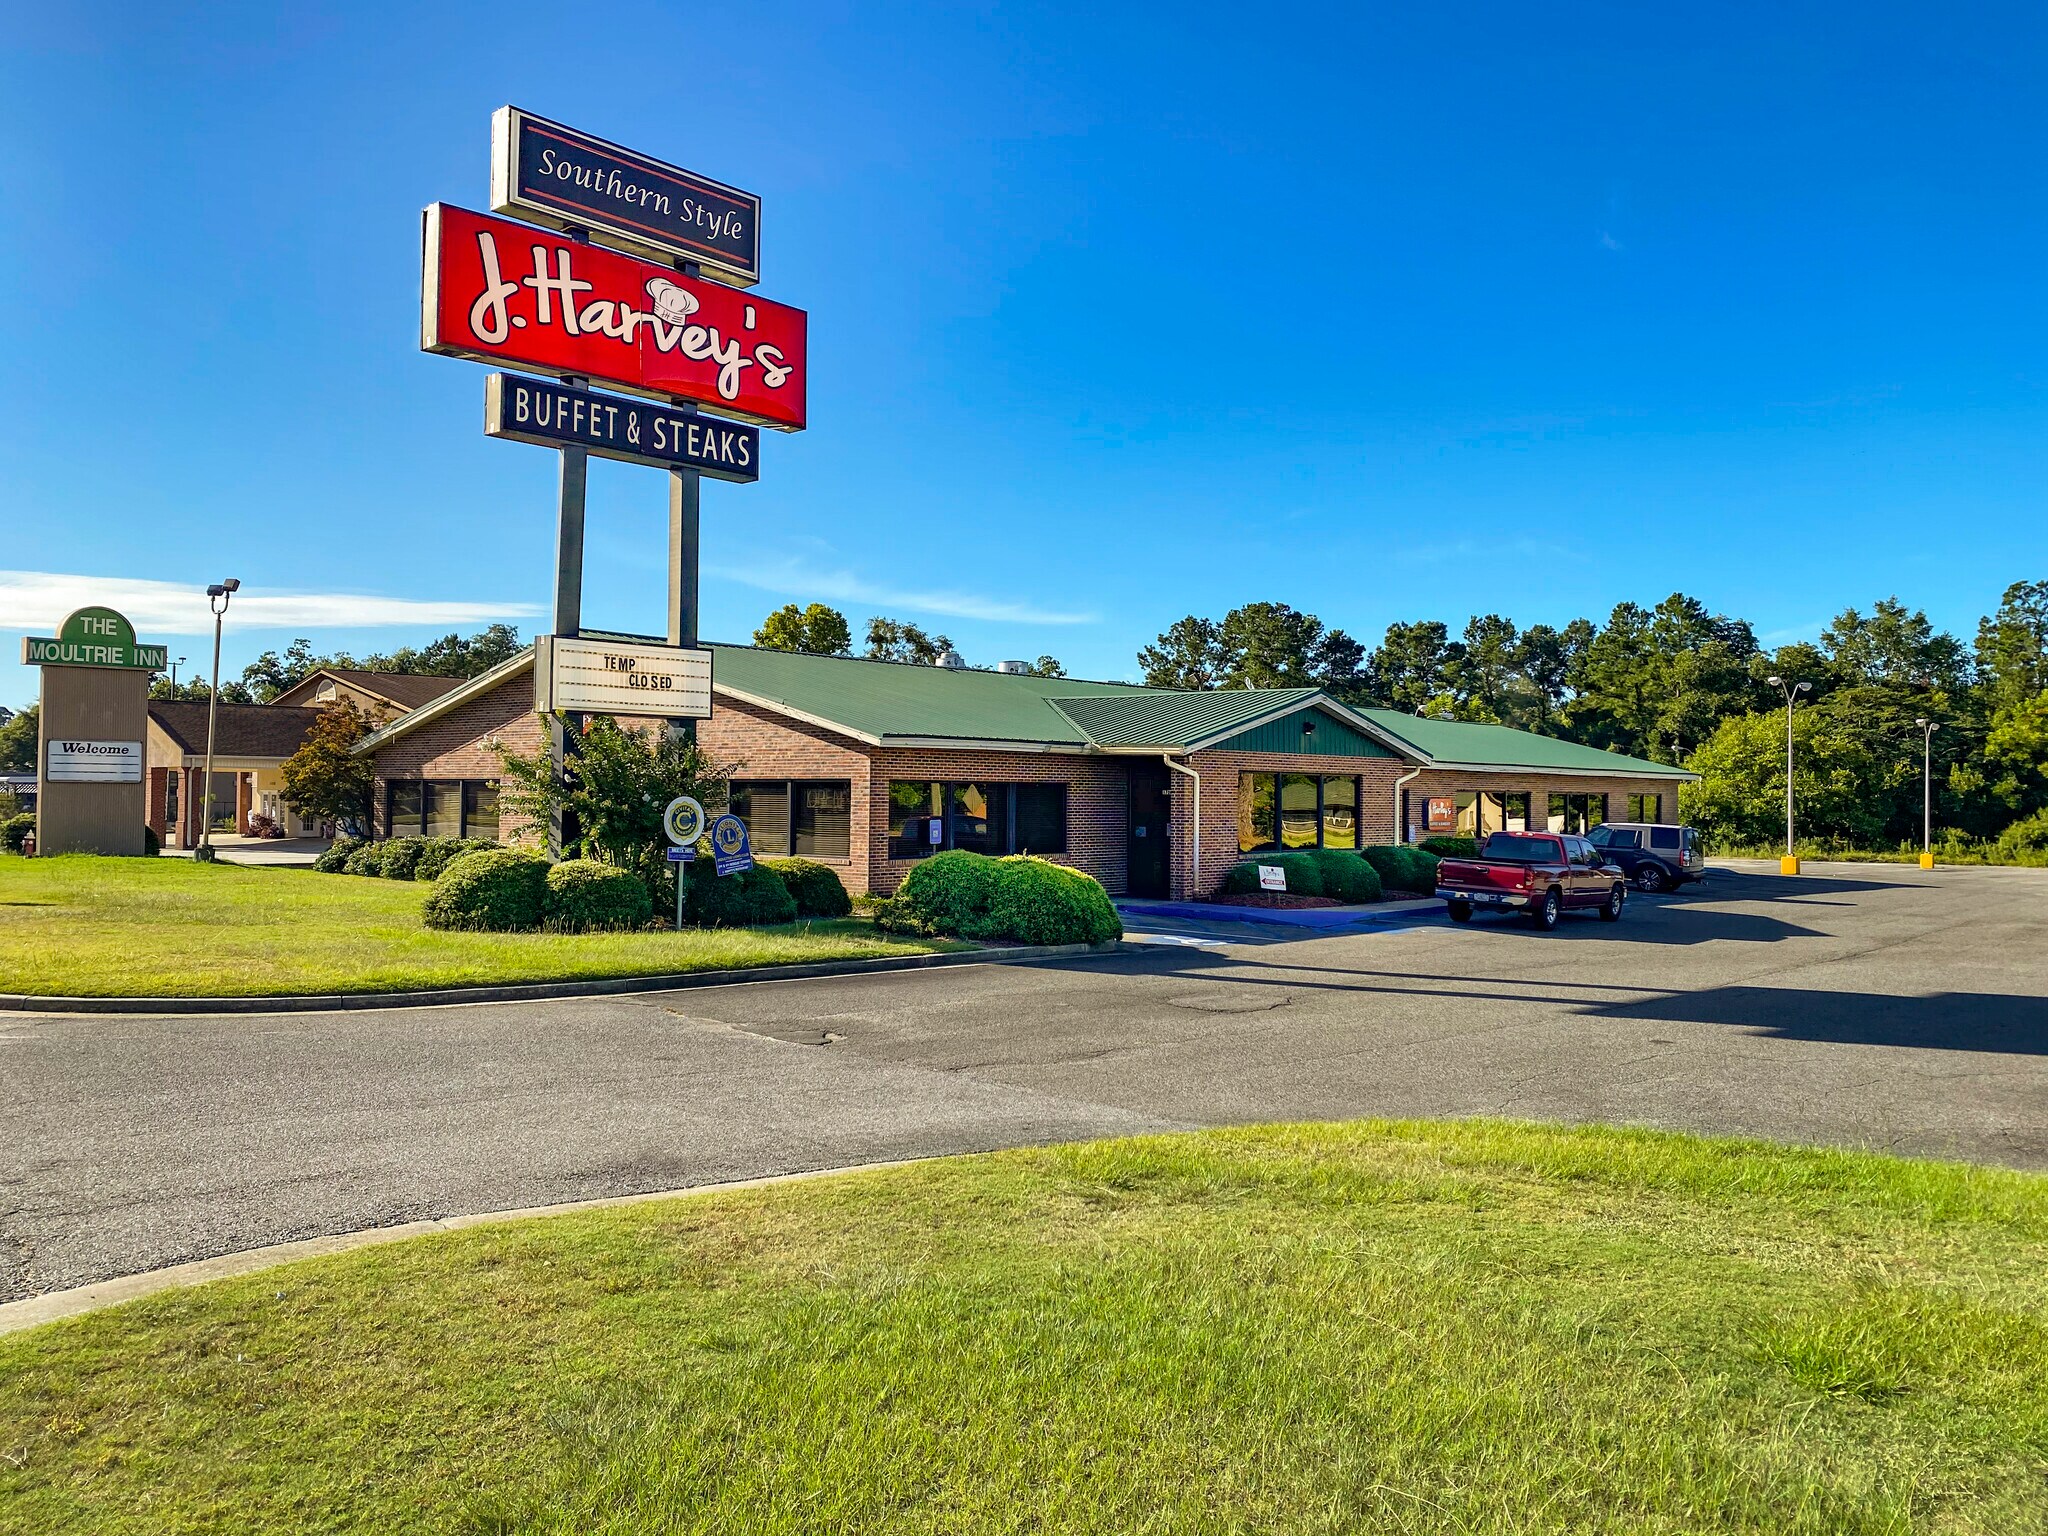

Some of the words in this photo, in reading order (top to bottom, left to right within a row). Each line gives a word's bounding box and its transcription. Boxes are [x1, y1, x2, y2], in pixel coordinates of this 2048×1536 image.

[538, 149, 671, 214] Southern
[680, 198, 743, 241] Style
[469, 231, 794, 401] J.Harvey's
[515, 387, 619, 438] BUFFET
[627, 411, 641, 445] &
[653, 417, 751, 467] STEAKS
[80, 616, 118, 636] THE
[29, 642, 124, 665] MOULTRIE
[133, 648, 163, 667] INN
[604, 656, 636, 671] TEMP
[628, 674, 672, 689] CLOSED
[61, 742, 130, 755] Welcome
